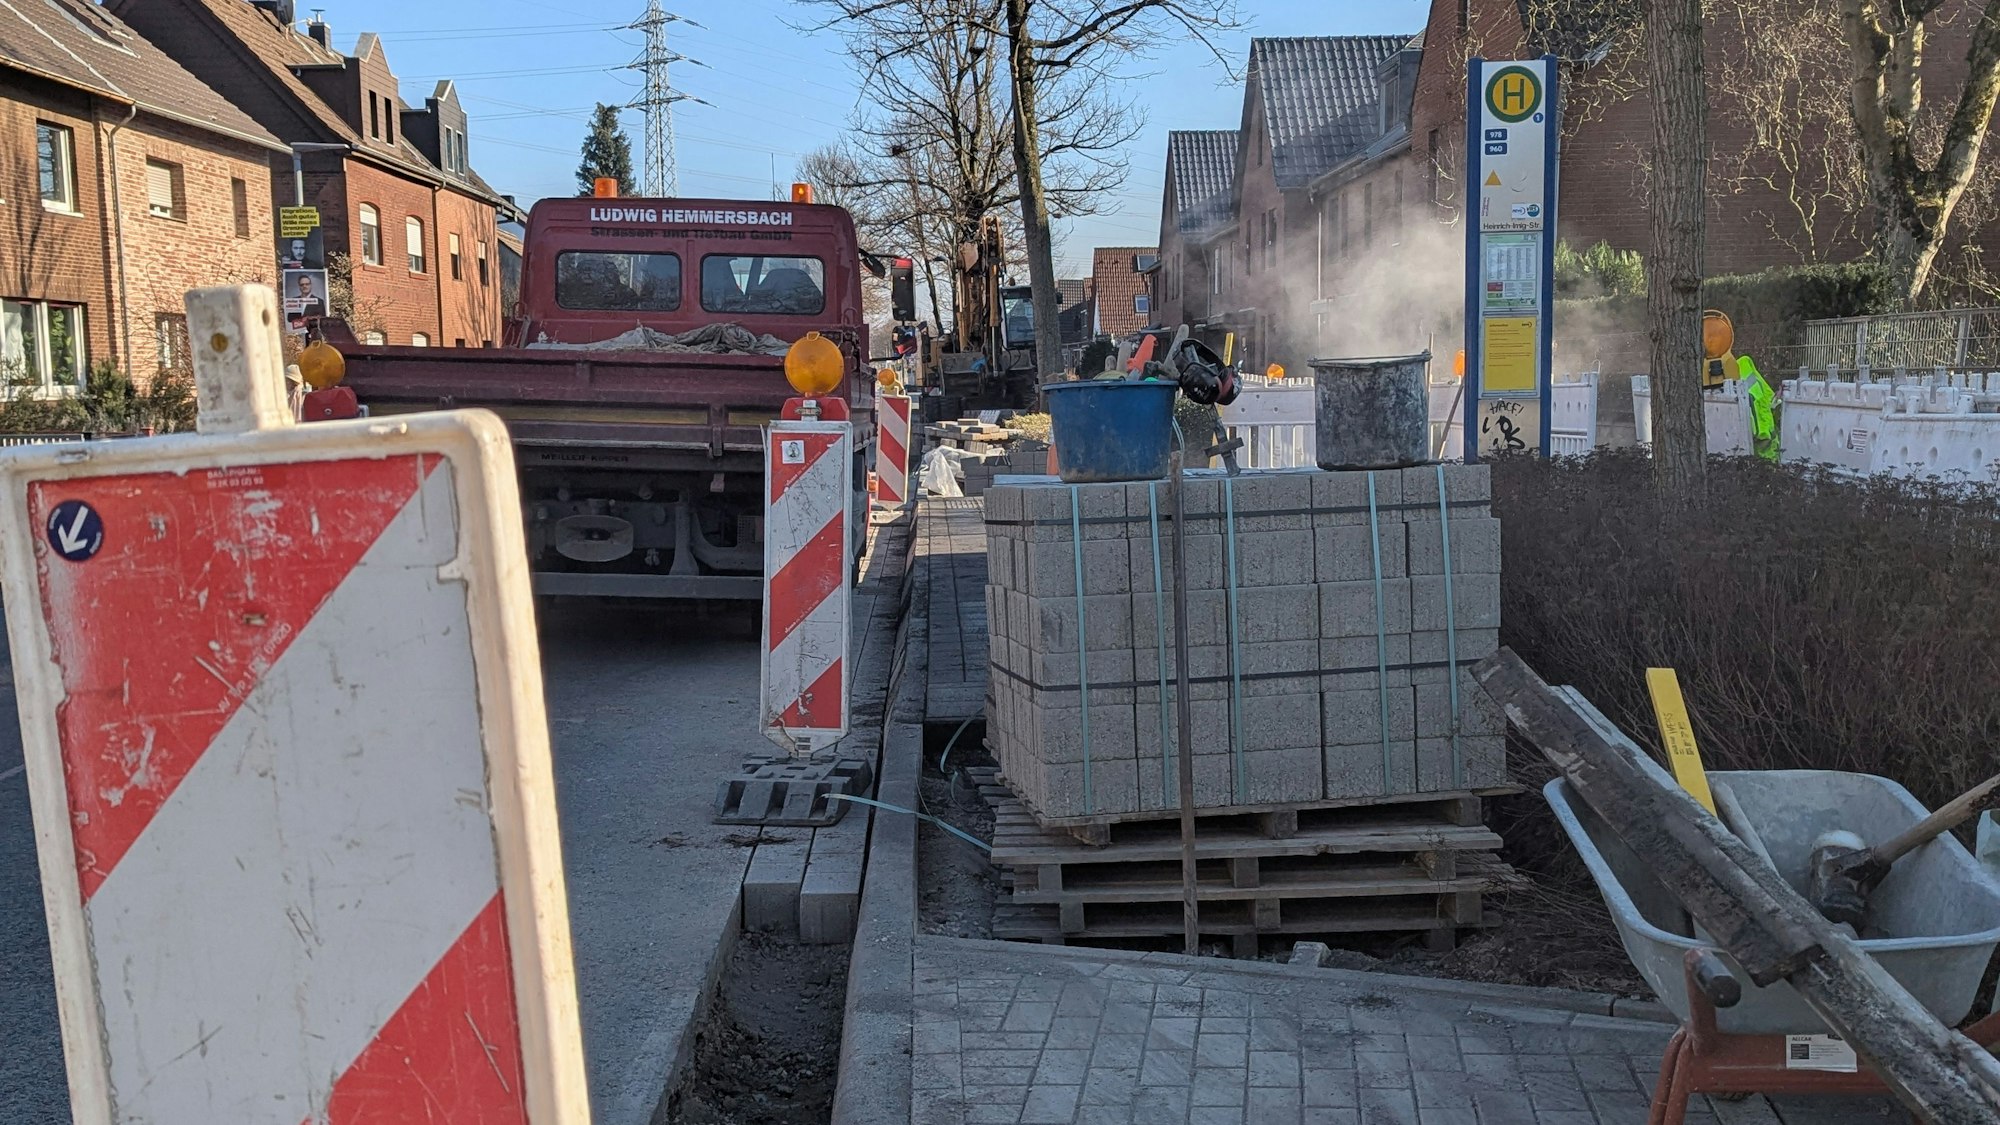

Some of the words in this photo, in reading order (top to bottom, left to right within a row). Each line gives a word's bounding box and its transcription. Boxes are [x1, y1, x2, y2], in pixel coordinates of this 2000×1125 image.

[1502, 78, 1525, 110] H
[1489, 131, 1503, 139] 978
[1489, 145, 1503, 153] 960
[590, 207, 657, 223] LUDWIG
[661, 208, 793, 226] HEMMERSBACH
[750, 230, 792, 241] GmbH
